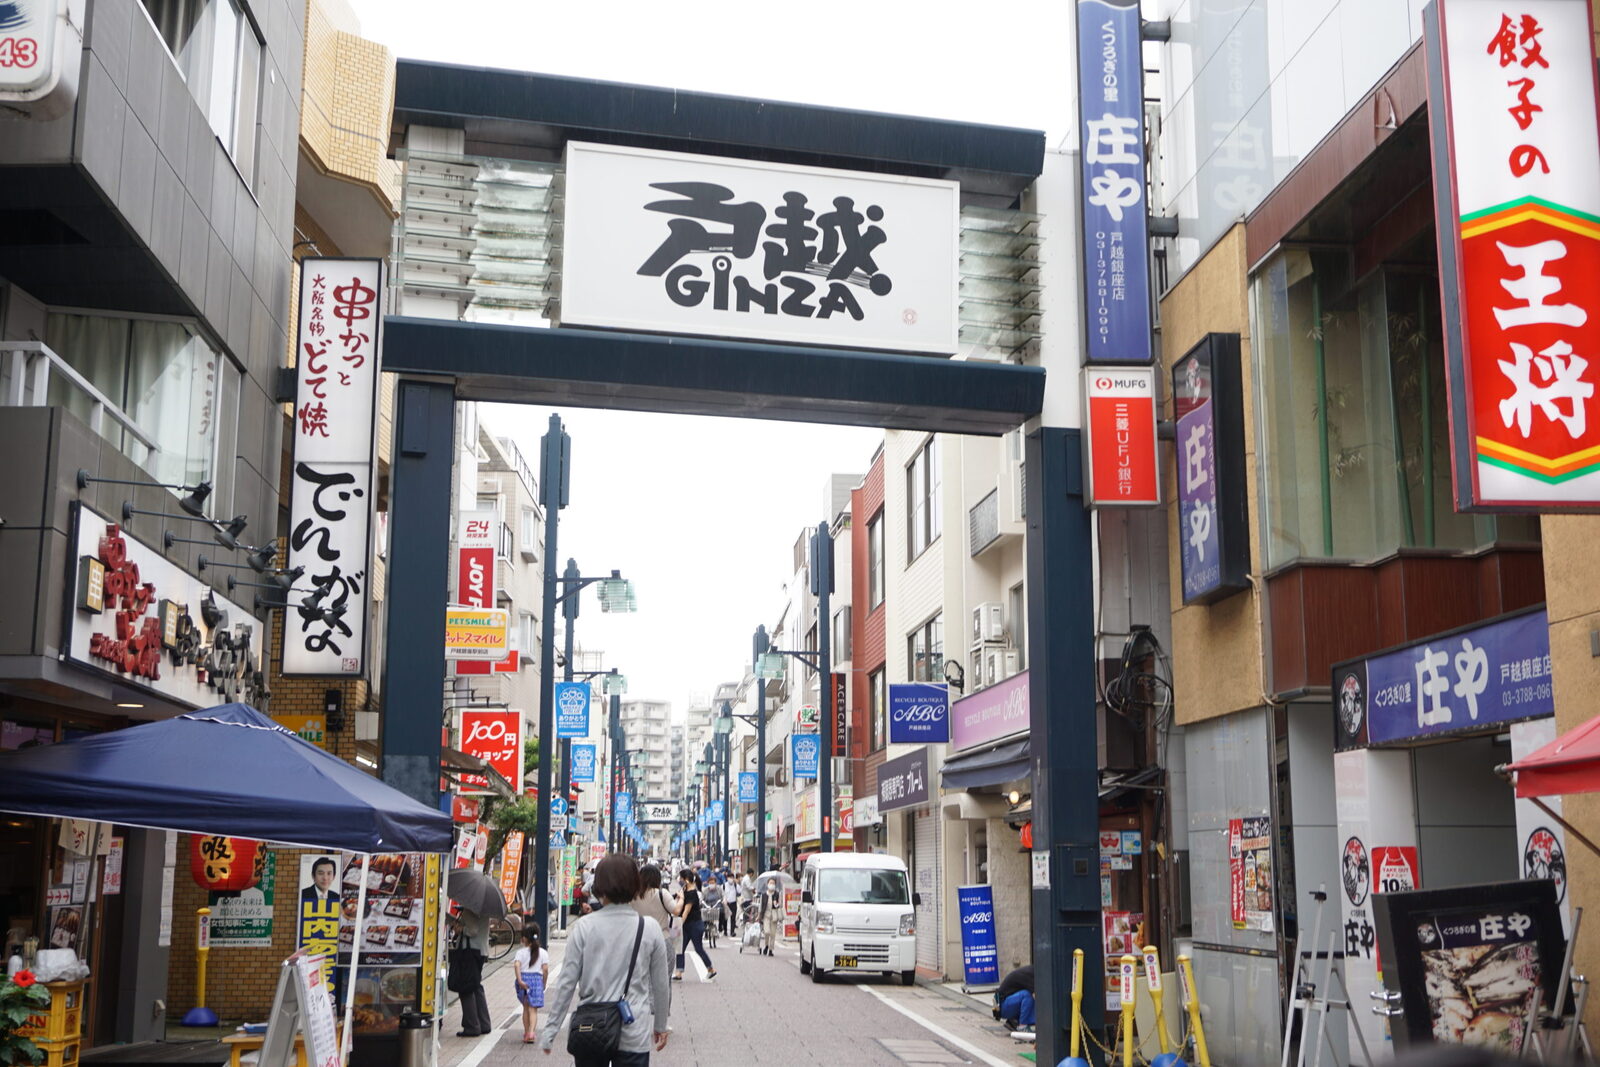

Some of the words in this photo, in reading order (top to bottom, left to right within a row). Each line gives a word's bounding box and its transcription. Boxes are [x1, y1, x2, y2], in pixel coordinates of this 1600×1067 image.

[1101, 20, 1118, 102] くつろぎの里
[1487, 13, 1550, 178] 餃子の
[1087, 113, 1142, 222] 庄や
[665, 255, 864, 321] GINZA
[1492, 240, 1594, 439] 王将
[1114, 379, 1146, 389] MUFG
[1115, 403, 1132, 495] 三菱UFJ銀行
[1185, 425, 1210, 562] 庄や
[466, 521, 489, 532] 24
[449, 618, 491, 626] PETSMILE
[1415, 638, 1489, 728] 庄や
[1500, 654, 1552, 685] 戸越銀座店
[837, 684, 846, 705] ACE
[1374, 681, 1411, 708] くつろぎの里
[1502, 683, 1554, 706] 03-3788-096
[837, 713, 846, 741] CARE
[893, 704, 946, 722] ABC
[963, 912, 992, 924] ABC
[1479, 912, 1531, 941] 庄や
[1344, 919, 1375, 960] 庄や
